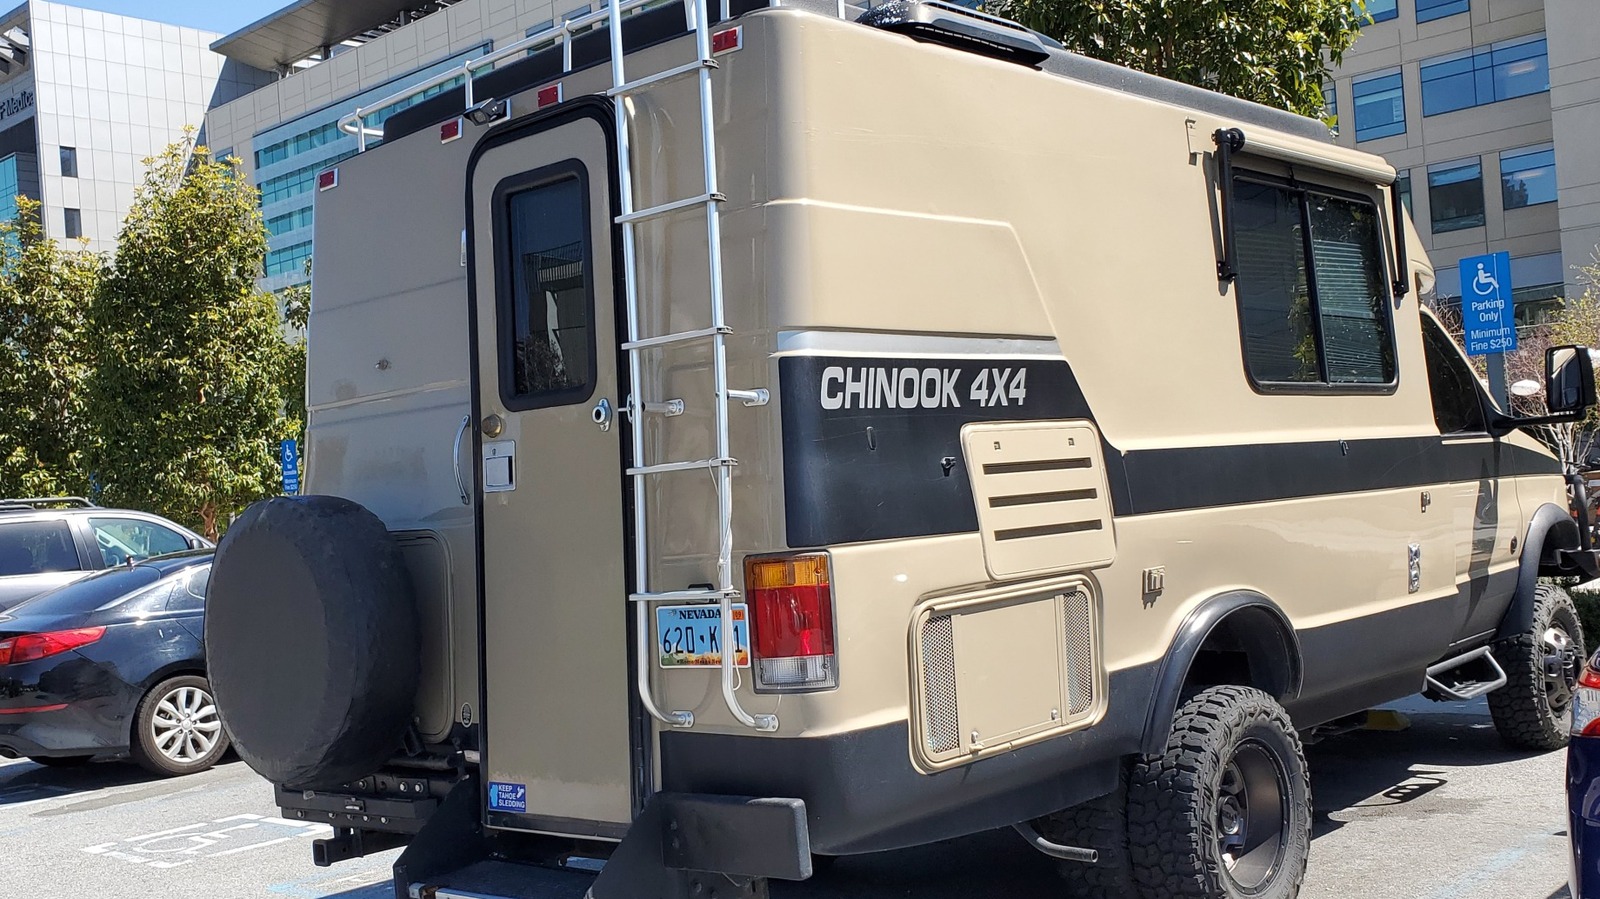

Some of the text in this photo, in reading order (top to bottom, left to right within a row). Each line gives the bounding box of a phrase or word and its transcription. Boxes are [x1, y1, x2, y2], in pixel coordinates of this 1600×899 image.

[1472, 299, 1505, 312] Parking
[1480, 312, 1499, 323] Only
[1471, 327, 1511, 340] Minimum
[1471, 337, 1513, 352] Fine $250
[820, 366, 1027, 410] CHINOOK 4X4
[679, 609, 721, 619] NEVADA
[499, 784, 513, 792] KEEP
[499, 791, 517, 800] TAHOE
[498, 799, 525, 809] SLEDDING
